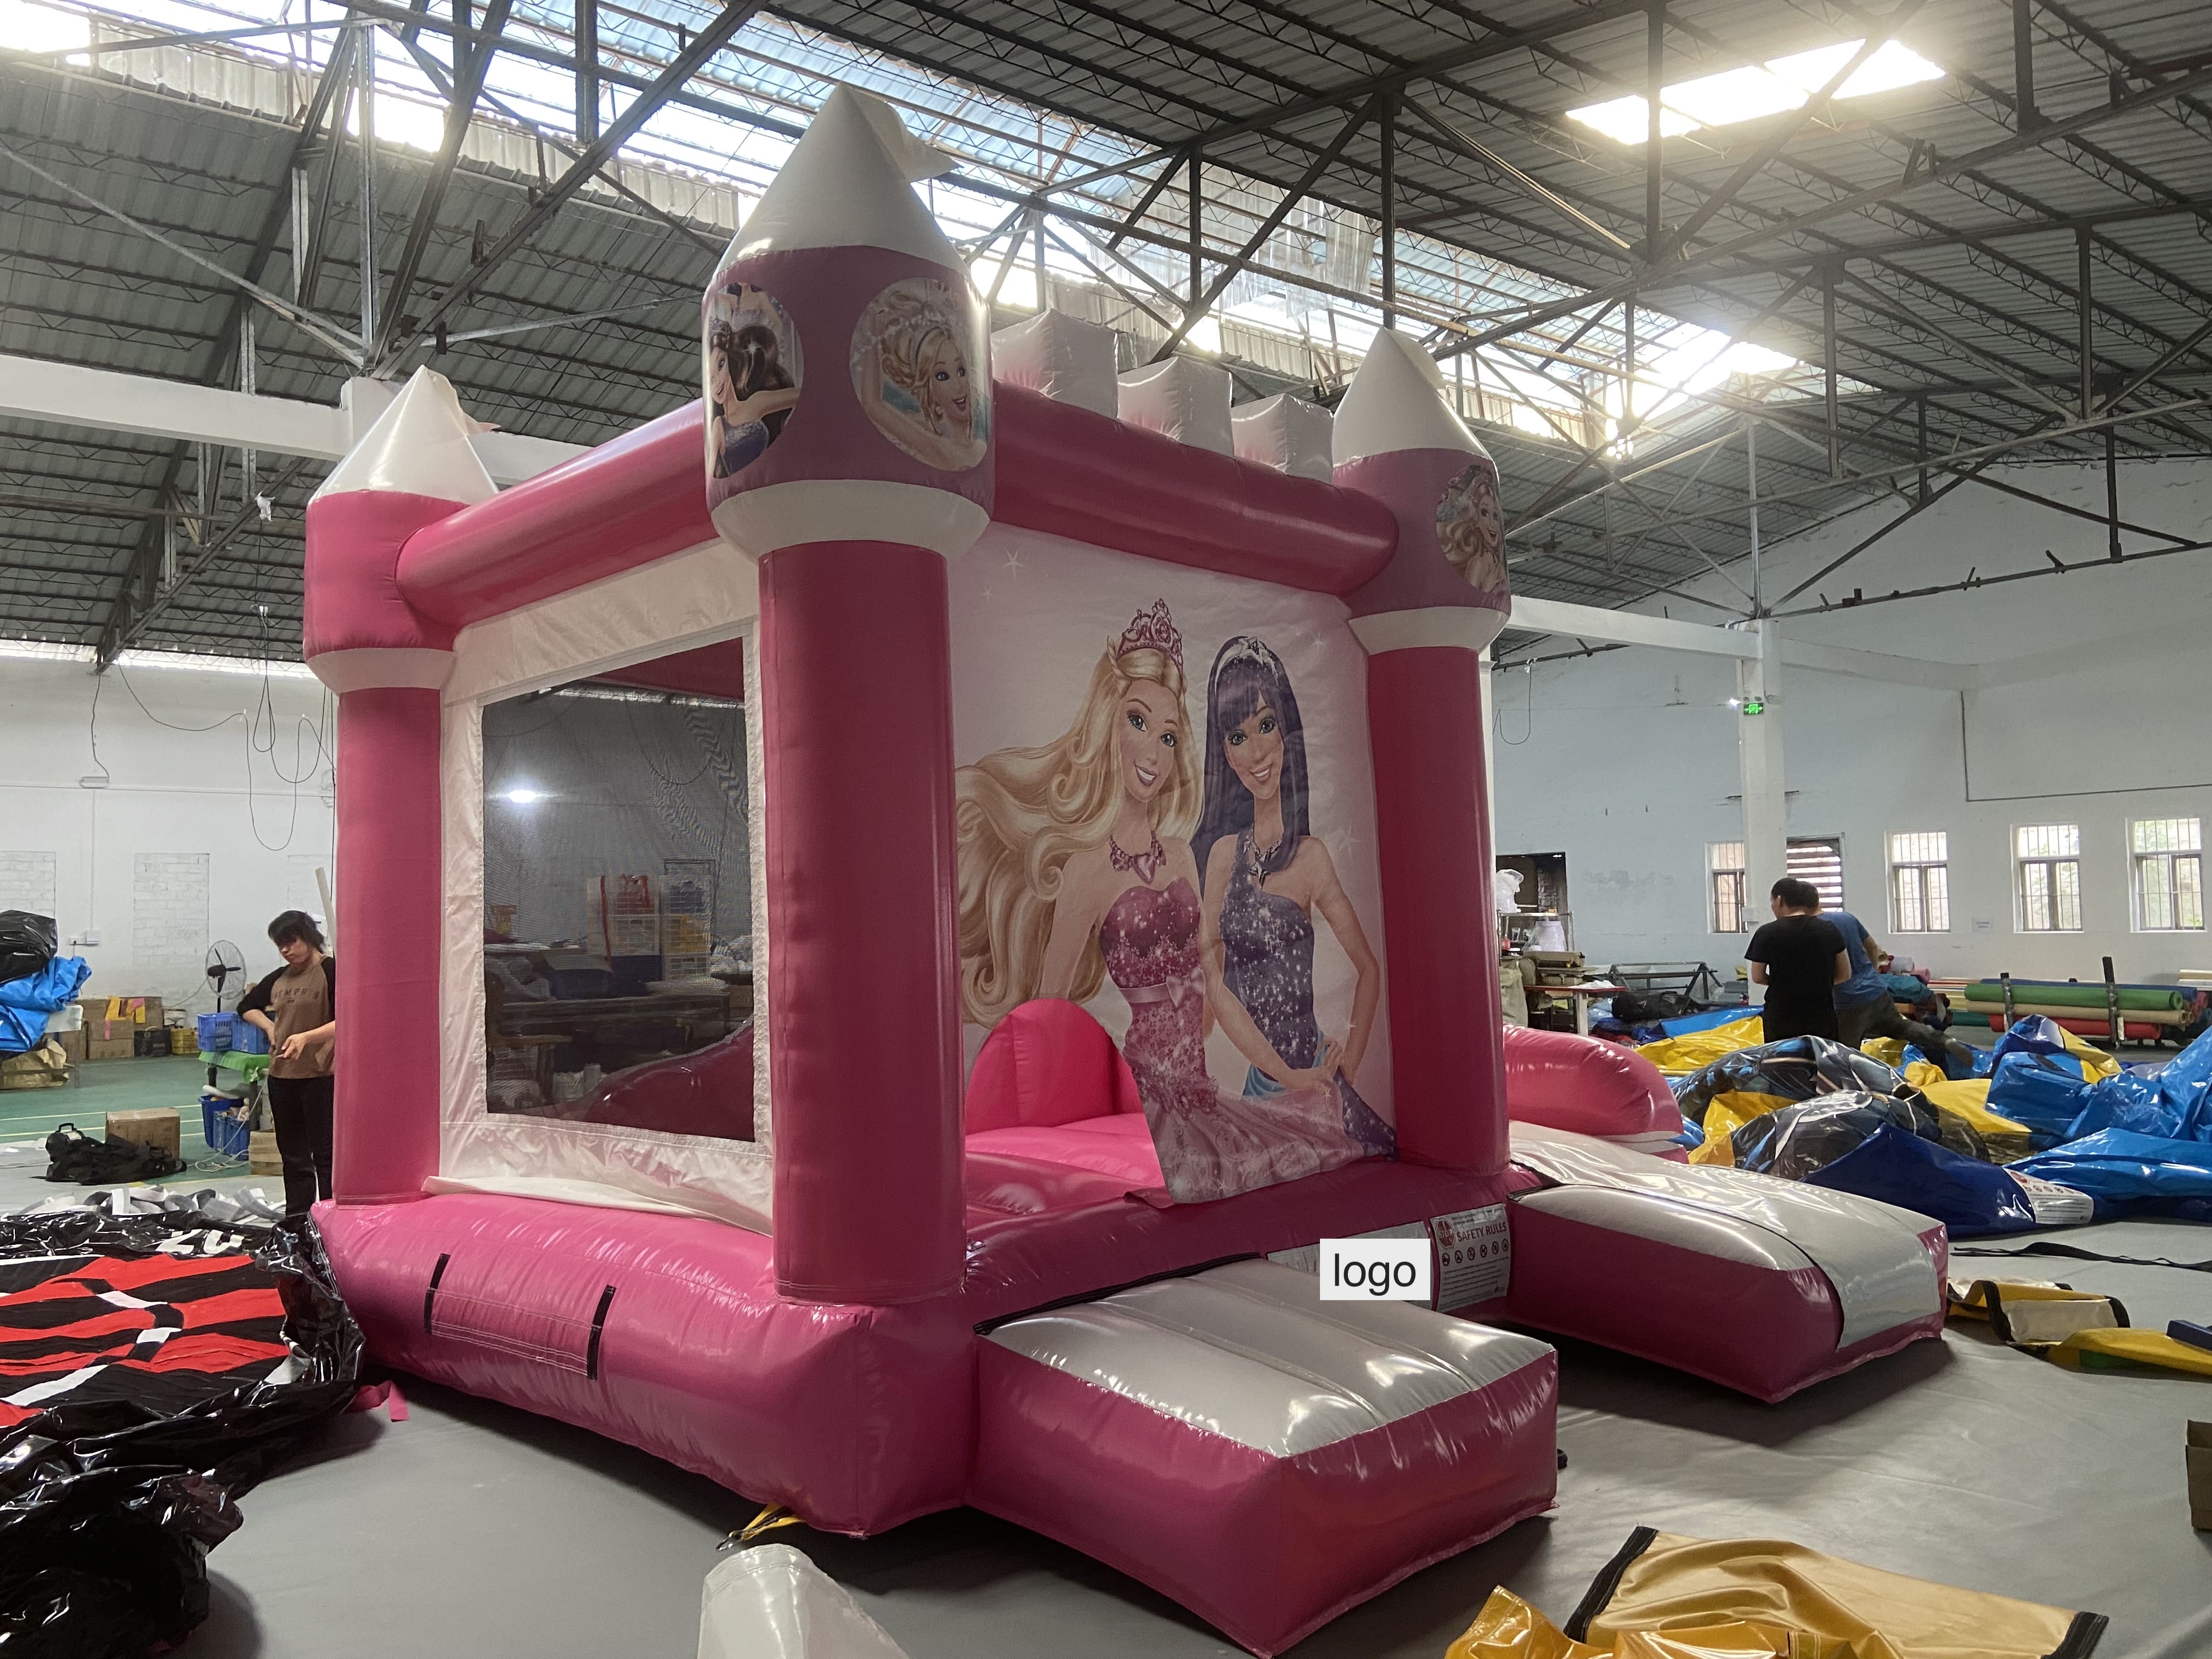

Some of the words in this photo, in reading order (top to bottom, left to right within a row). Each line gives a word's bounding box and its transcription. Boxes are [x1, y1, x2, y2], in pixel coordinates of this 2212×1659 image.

[273, 988, 320, 1000] EMPHS
[1457, 1228, 1484, 1242] SAFETY
[1485, 1222, 1506, 1236] RULES
